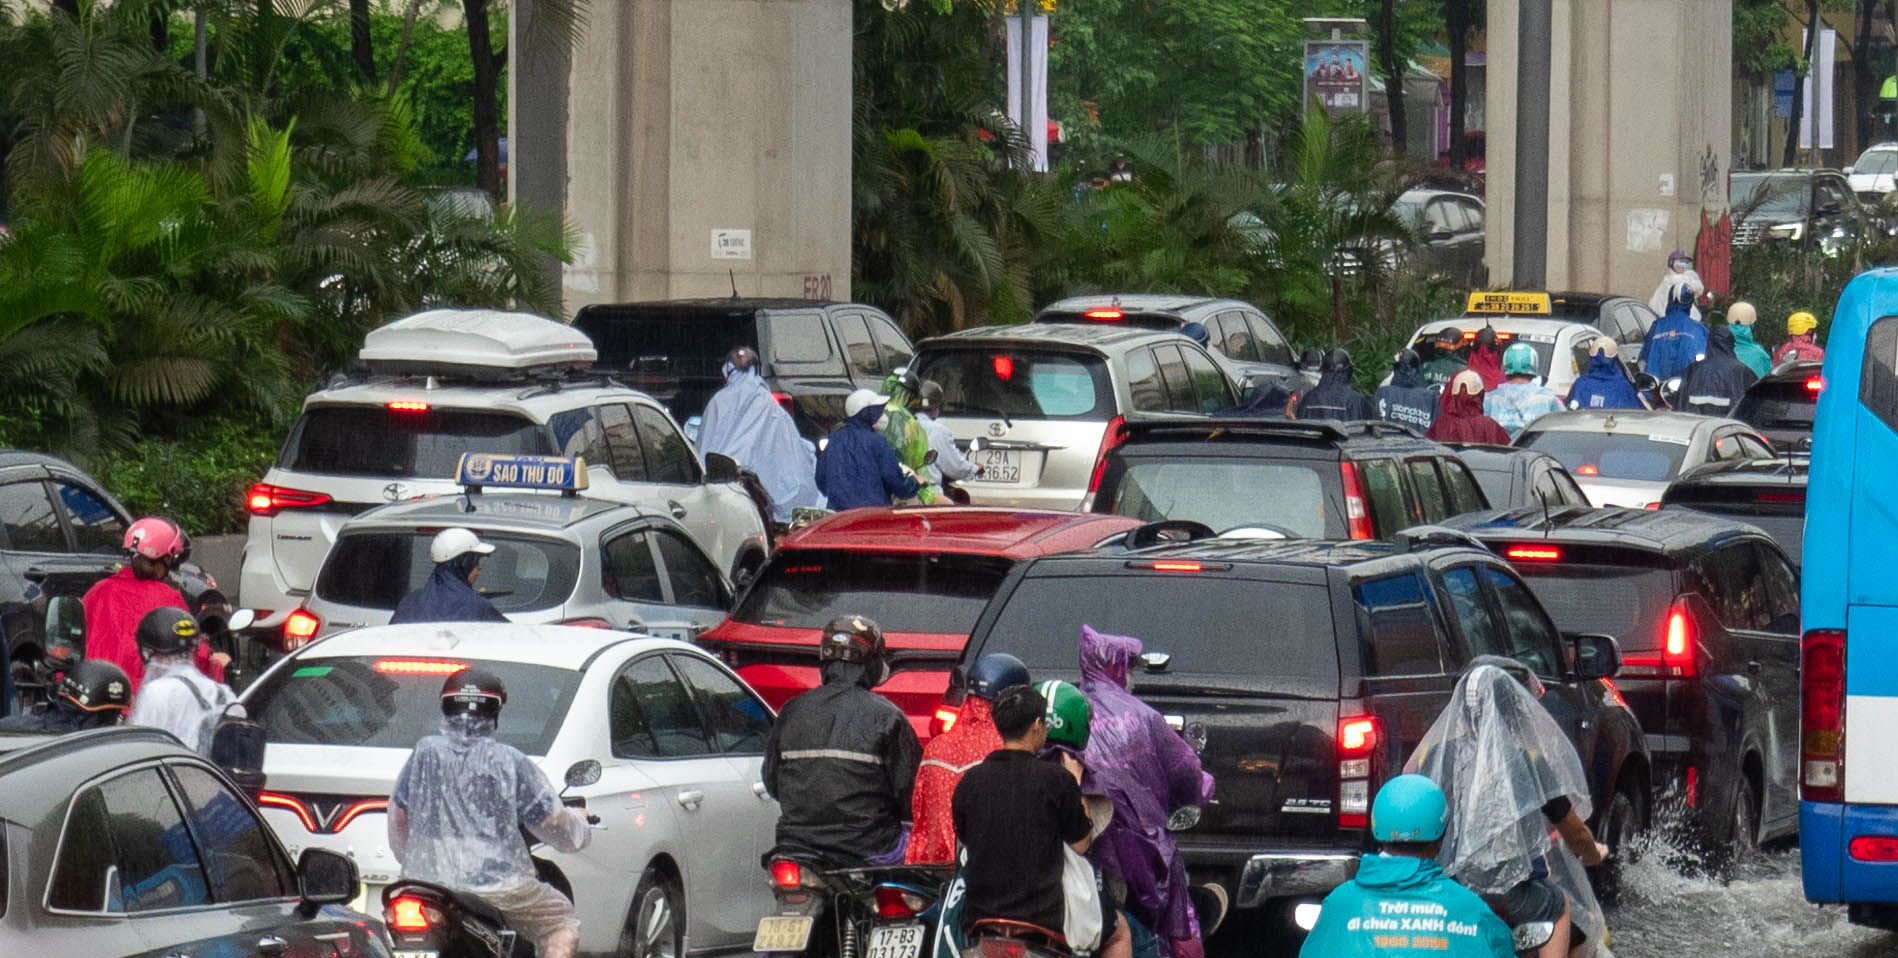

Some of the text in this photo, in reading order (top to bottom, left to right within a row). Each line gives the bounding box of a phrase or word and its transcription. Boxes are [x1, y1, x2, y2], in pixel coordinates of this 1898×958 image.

[986, 450, 1009, 464] 29A
[493, 464, 518, 483] SAO
[1379, 901, 1448, 917] Trời mưa,
[1362, 917, 1399, 931] chưa
[1400, 918, 1445, 932] XANH
[1447, 920, 1478, 936] đón!
[880, 929, 915, 946] 17-B3
